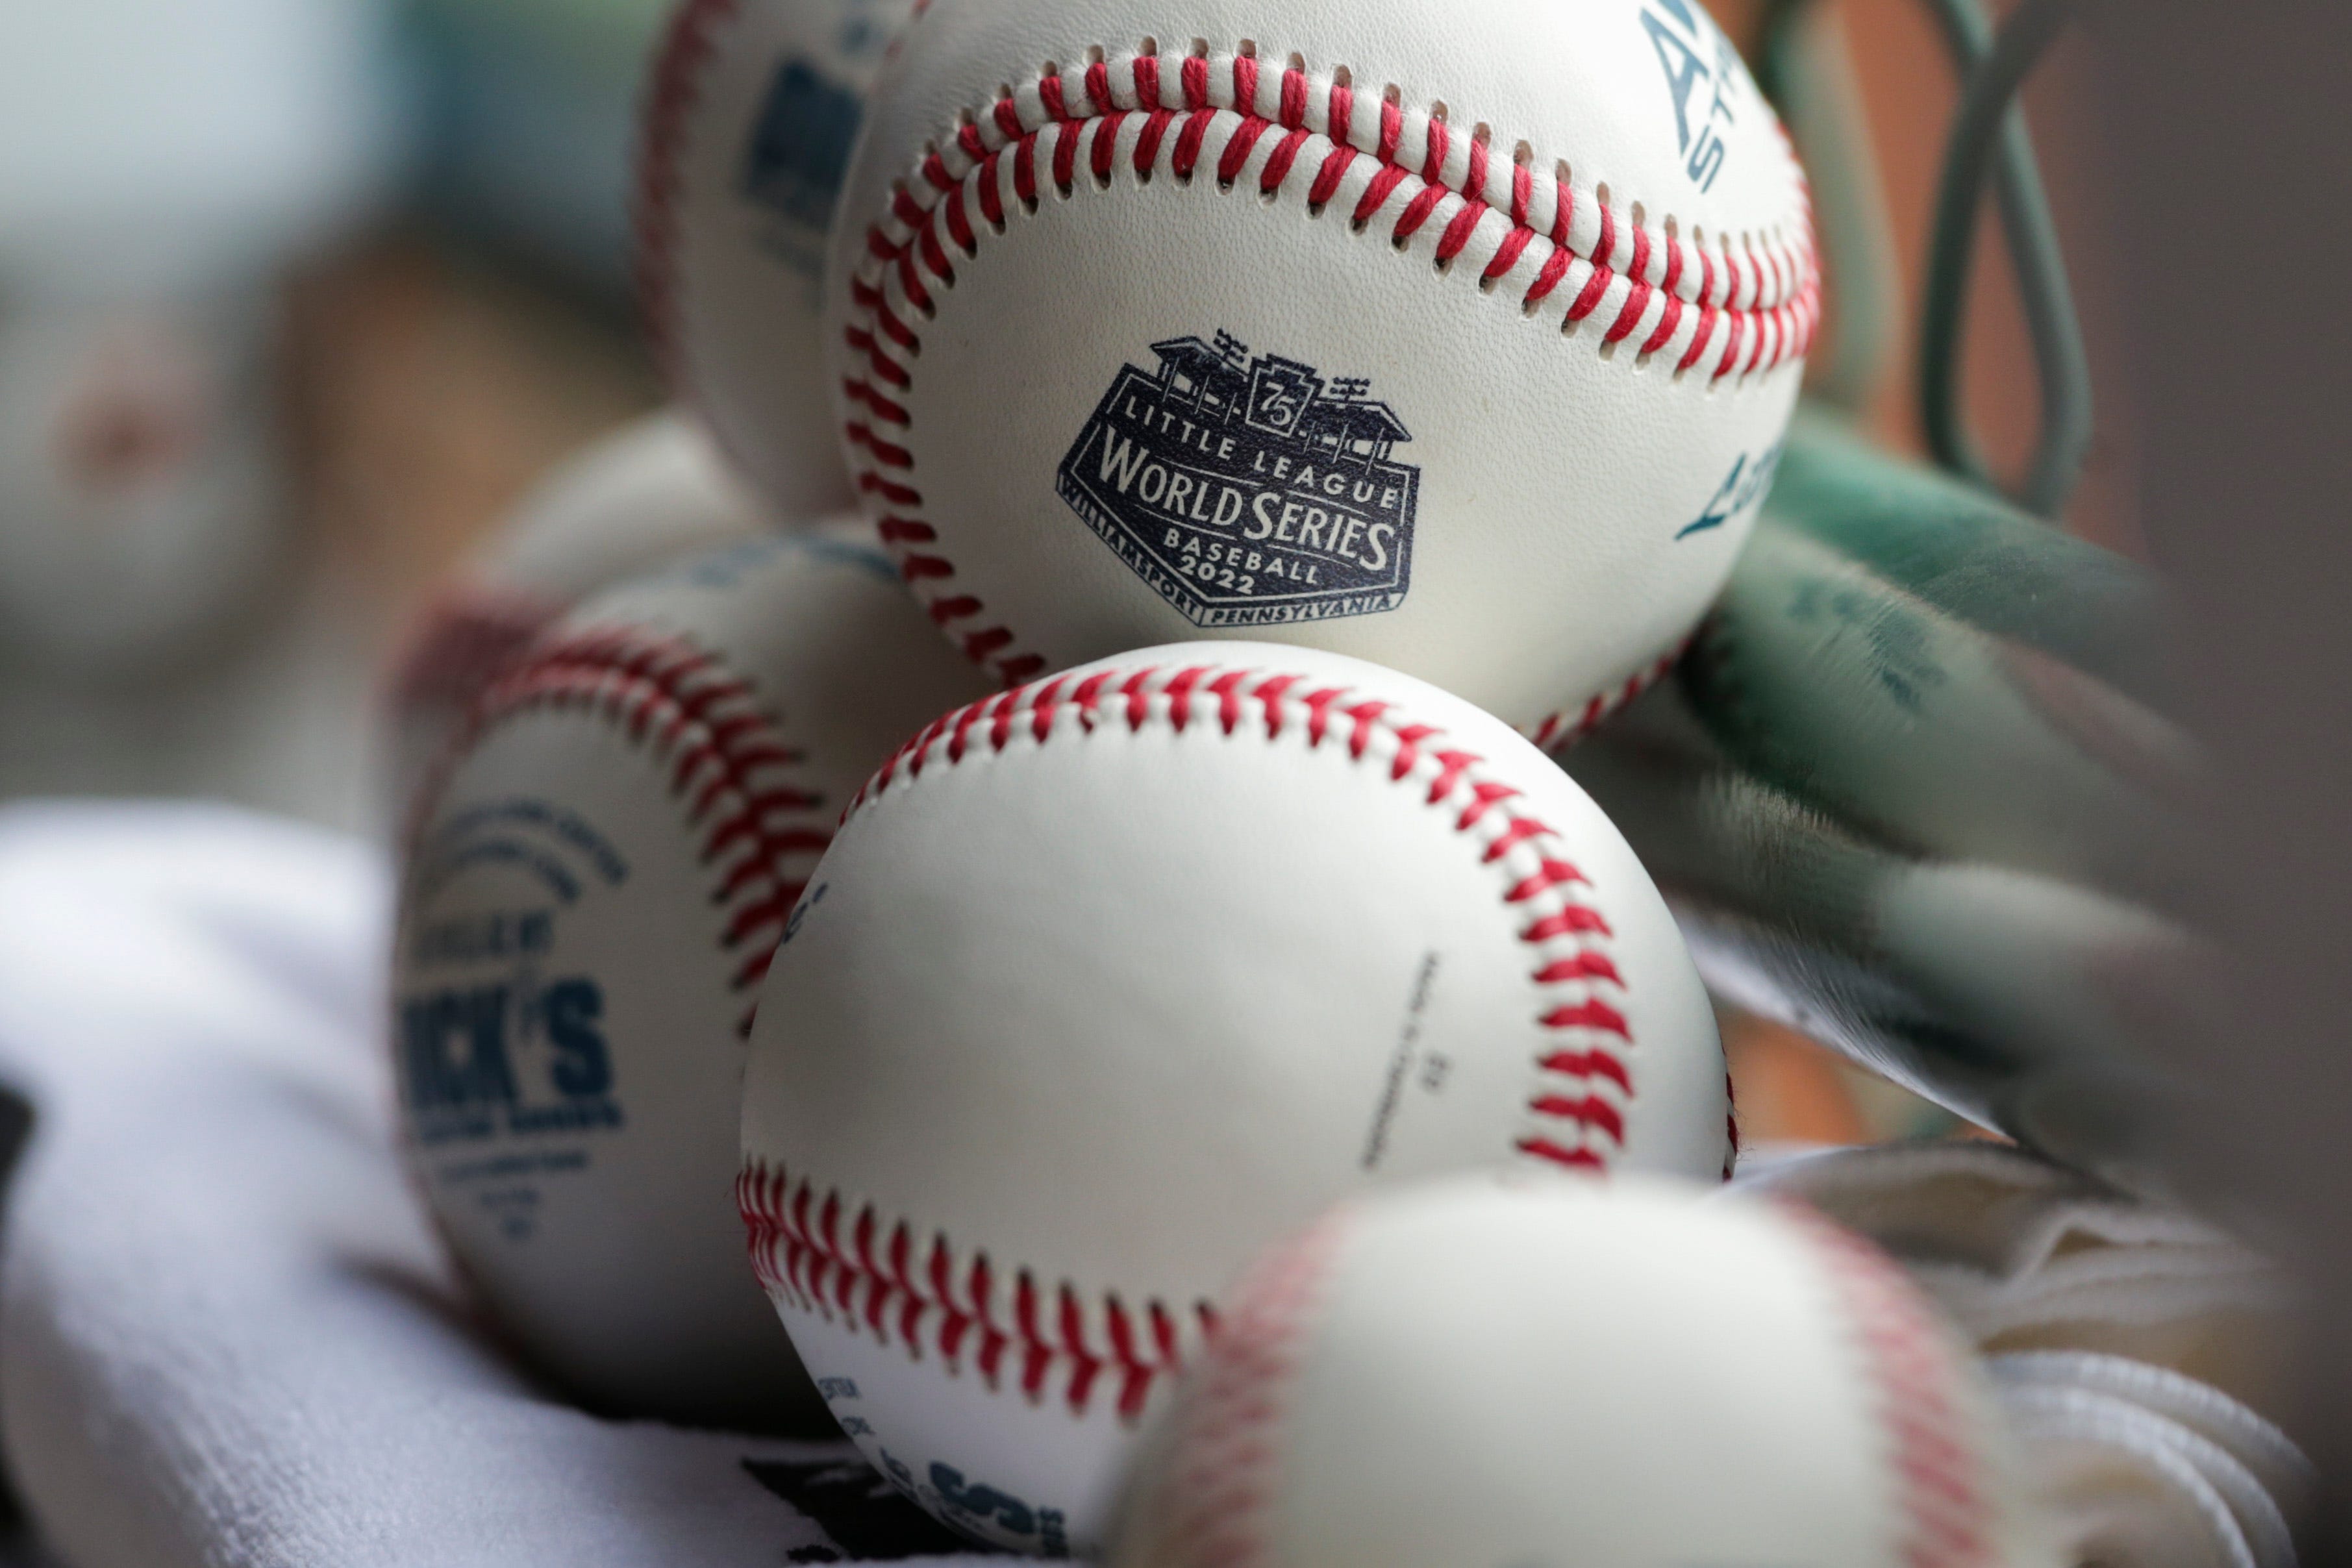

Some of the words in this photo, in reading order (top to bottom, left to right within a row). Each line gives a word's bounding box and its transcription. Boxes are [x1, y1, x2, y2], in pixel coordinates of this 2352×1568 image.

[1262, 382, 1293, 427] 75
[1124, 394, 1236, 462] LITTLE
[1253, 449, 1398, 510] LEAGUE
[1097, 424, 1244, 527] WORLD
[1244, 492, 1394, 571] SERIES
[1059, 477, 1199, 617] WILLIAMSPORT
[1211, 593, 1390, 624] PENNSYLVANIA
[1164, 528, 1318, 585] BASEBALL
[1179, 555, 1256, 595] 2022
